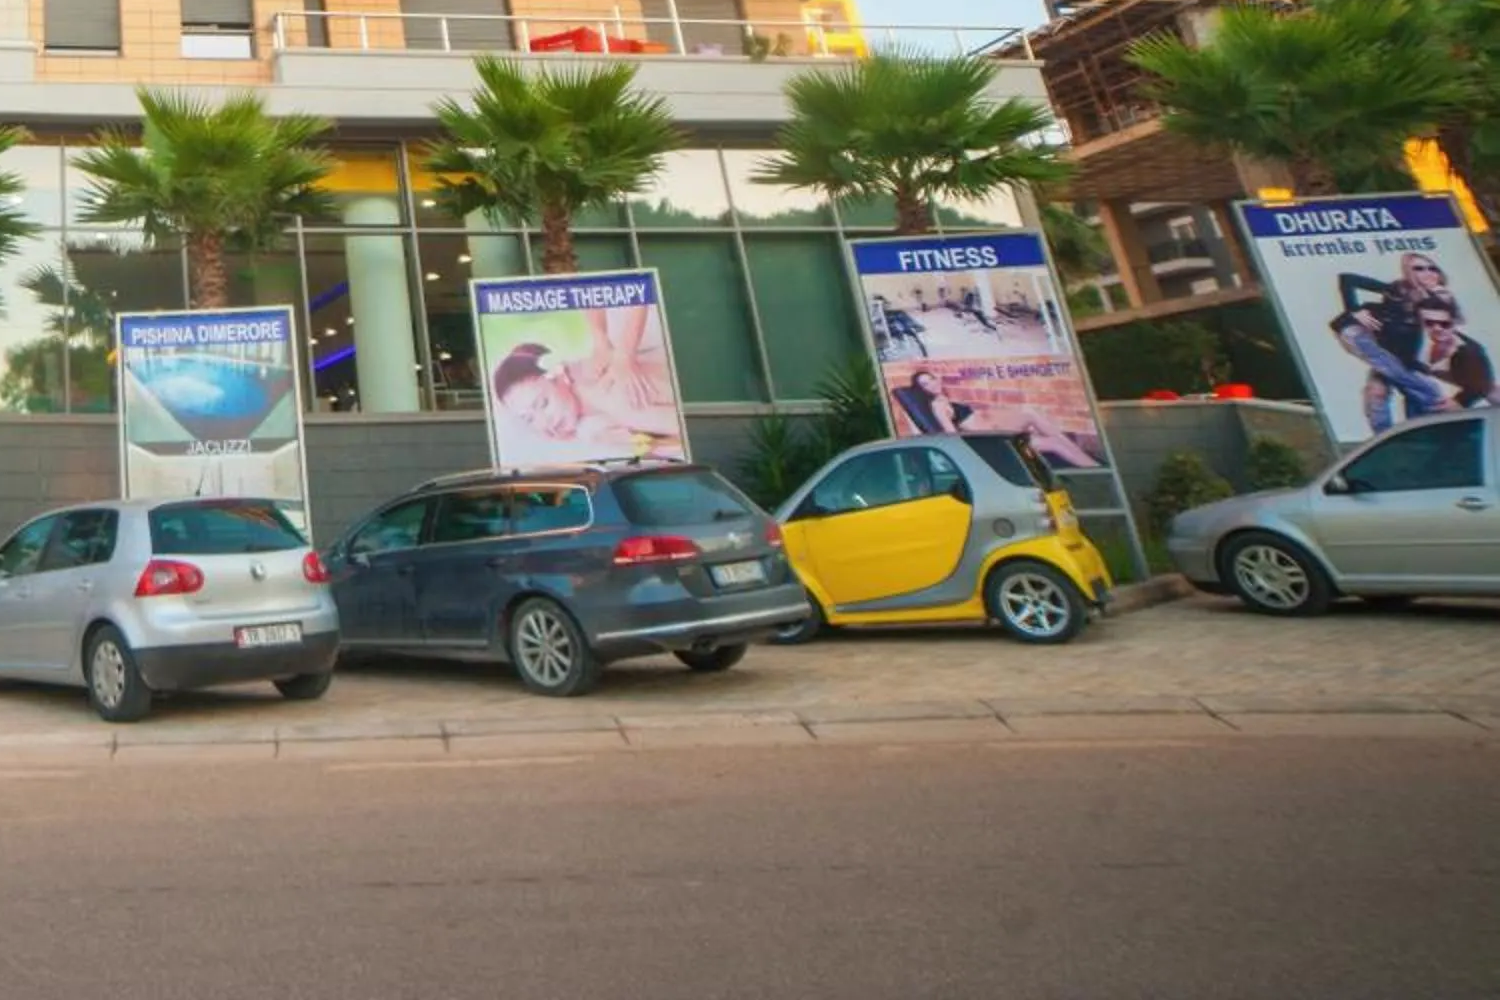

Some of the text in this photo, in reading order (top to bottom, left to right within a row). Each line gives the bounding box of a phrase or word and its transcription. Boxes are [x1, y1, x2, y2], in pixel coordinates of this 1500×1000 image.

[1276, 208, 1401, 233] DHURATA
[899, 246, 998, 270] FITNESS
[487, 283, 646, 312] MASSAGE THERAPY
[131, 321, 285, 345] PISHINA DIMERORE
[187, 439, 252, 456] JACUZZI
